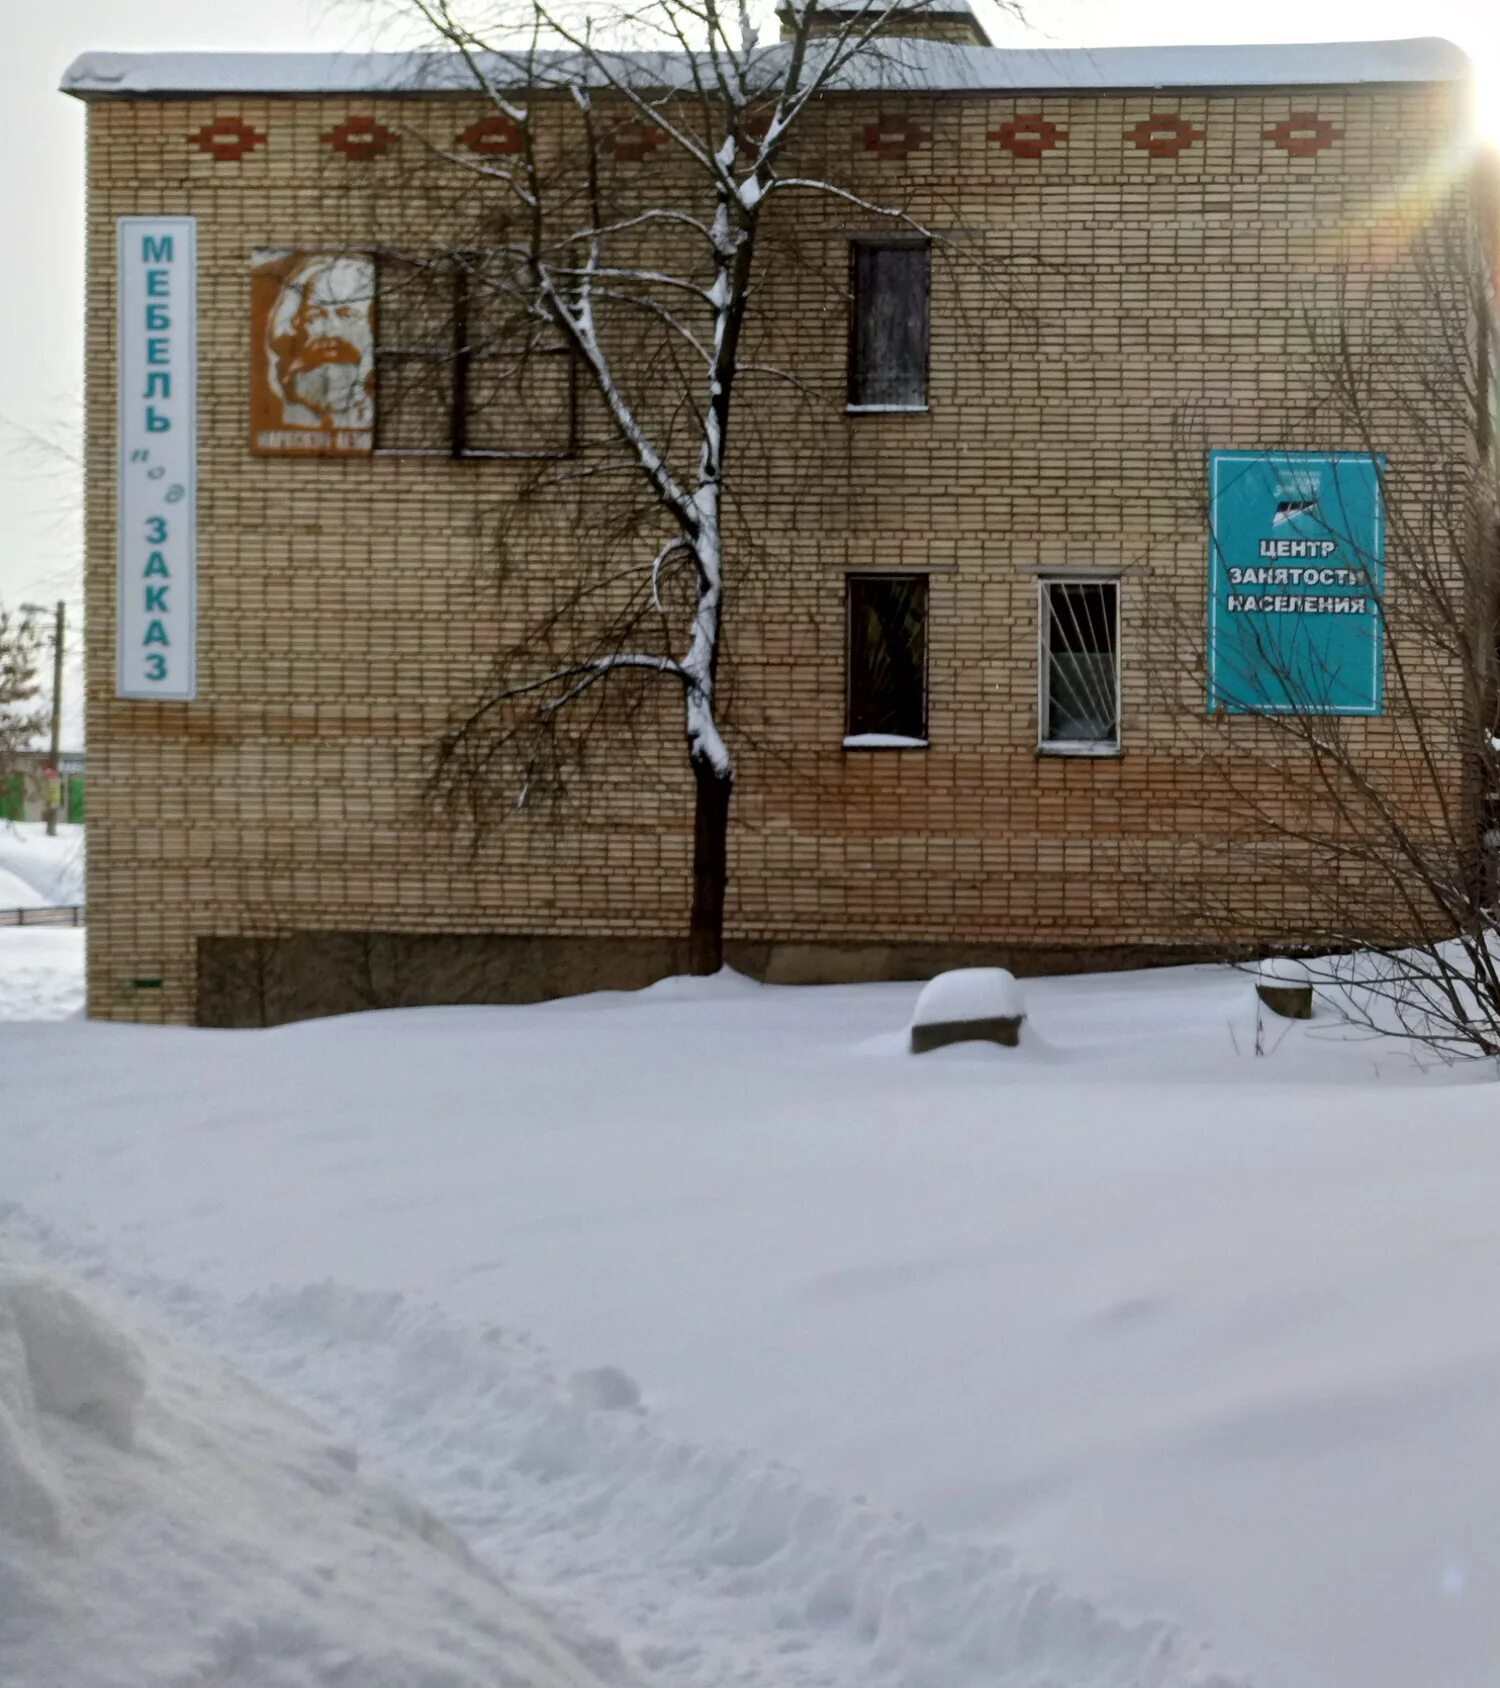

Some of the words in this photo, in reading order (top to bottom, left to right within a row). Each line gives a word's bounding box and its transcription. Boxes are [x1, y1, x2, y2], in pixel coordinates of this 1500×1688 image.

[141, 234, 175, 434] МЕБЕЛЬ
[1259, 540, 1336, 559] ЦЕНТР
[1229, 567, 1367, 586] ЗАНЯТОСТИ
[142, 516, 171, 683] ЗАКАЗ
[1227, 595, 1366, 614] НАСЕЛЕНИЯ
